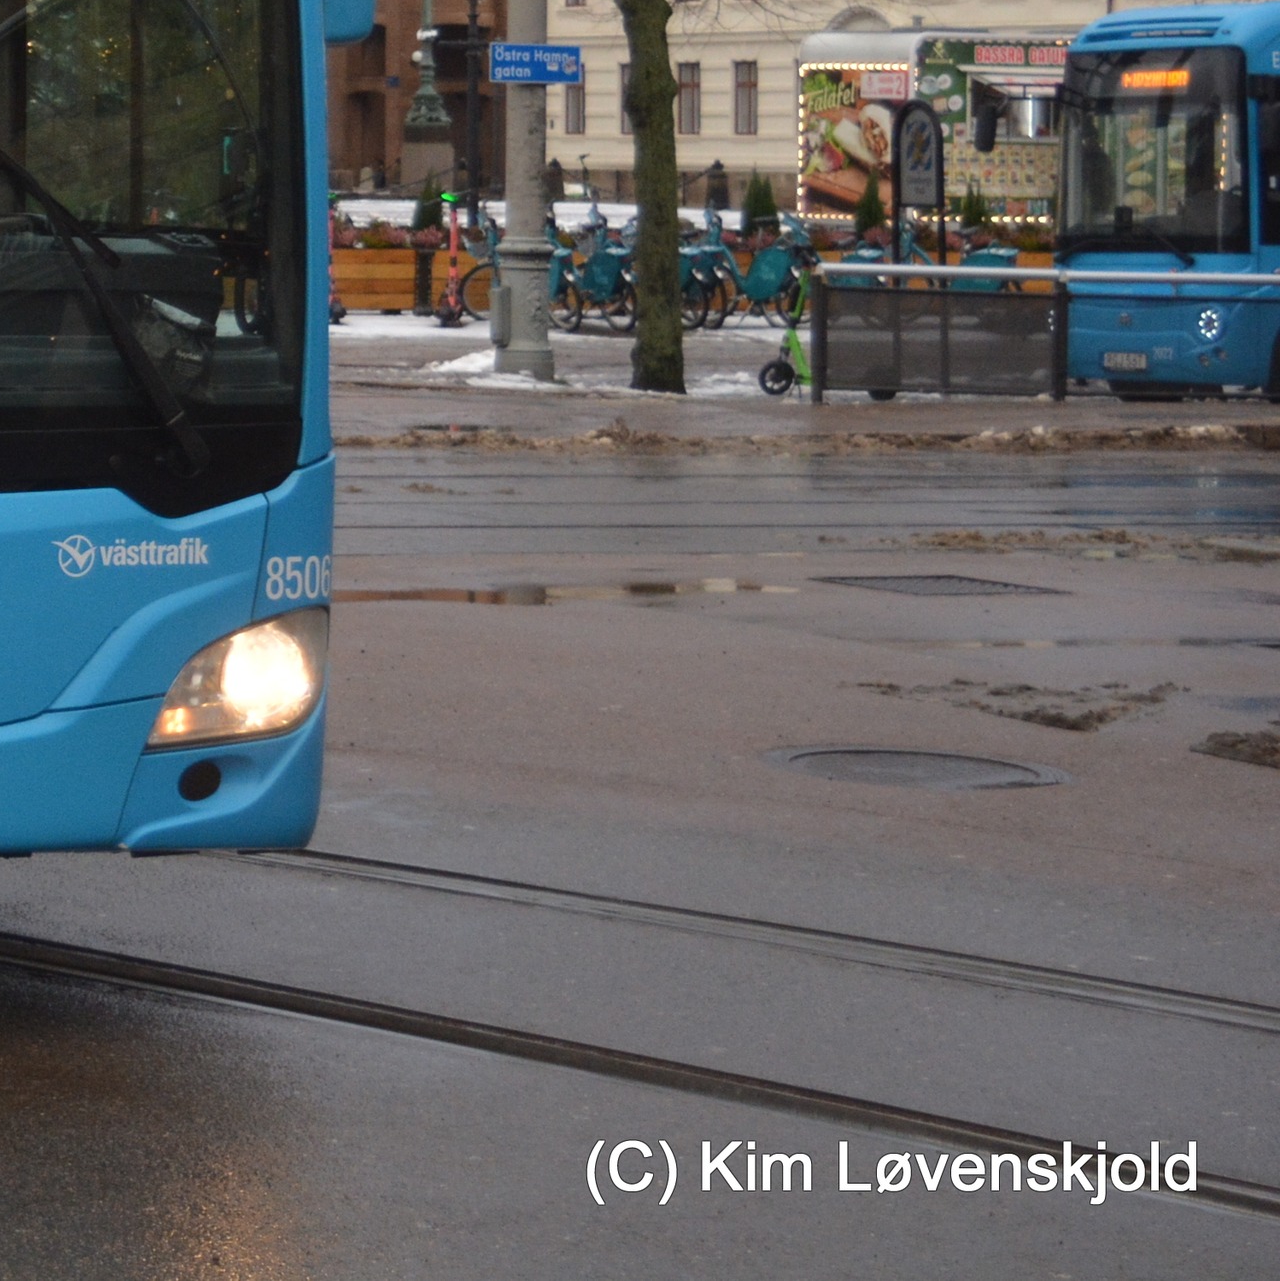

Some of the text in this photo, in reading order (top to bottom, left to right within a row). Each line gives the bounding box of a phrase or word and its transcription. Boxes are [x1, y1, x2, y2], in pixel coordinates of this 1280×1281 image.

[494, 45, 530, 62] Östra
[974, 45, 1025, 65] BASSRA
[494, 64, 531, 79] gatan
[99, 537, 209, 567] västtrafik
[265, 555, 331, 600] 8506
